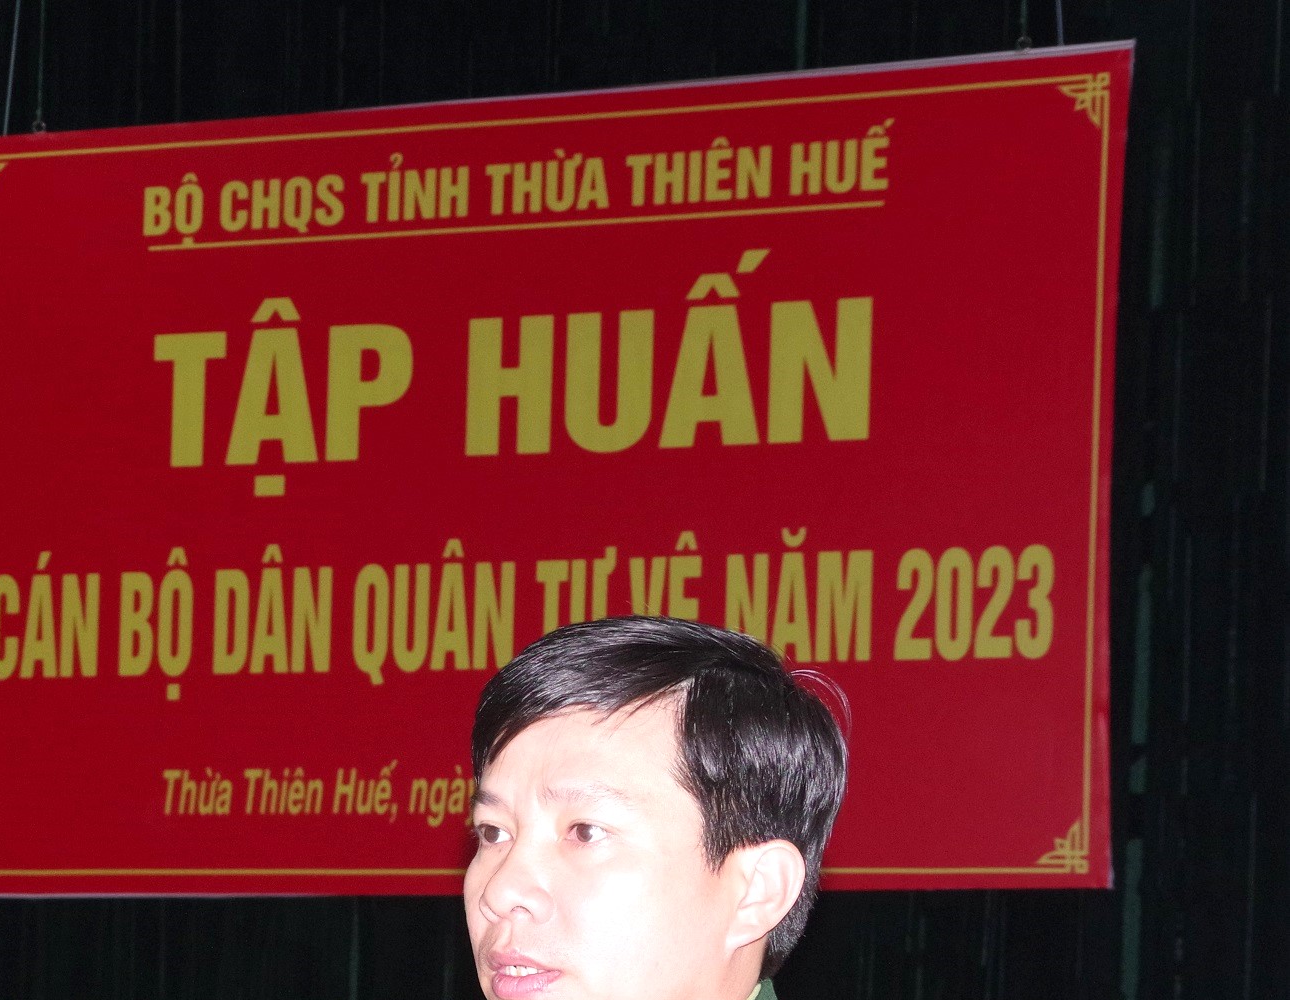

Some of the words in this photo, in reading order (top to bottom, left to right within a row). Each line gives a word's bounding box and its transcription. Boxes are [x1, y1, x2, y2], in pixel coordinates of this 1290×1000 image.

[143, 172, 204, 246] BỘ
[219, 174, 345, 233] CHQS
[360, 153, 470, 223] TỈNH
[485, 149, 609, 215] THỪA
[625, 137, 772, 207] THIÊN
[789, 118, 895, 196] HUẾ
[153, 296, 414, 497] TẬP
[465, 248, 874, 457] HUẤN
[118, 546, 194, 701] BỘ
[212, 543, 333, 676] DÂN
[352, 538, 516, 686] QUÂN
[724, 527, 874, 663] NĂM
[893, 544, 1055, 661] 2023
[163, 767, 233, 815] Thừa
[244, 767, 324, 815] Thiên
[331, 759, 398, 824] Huế,
